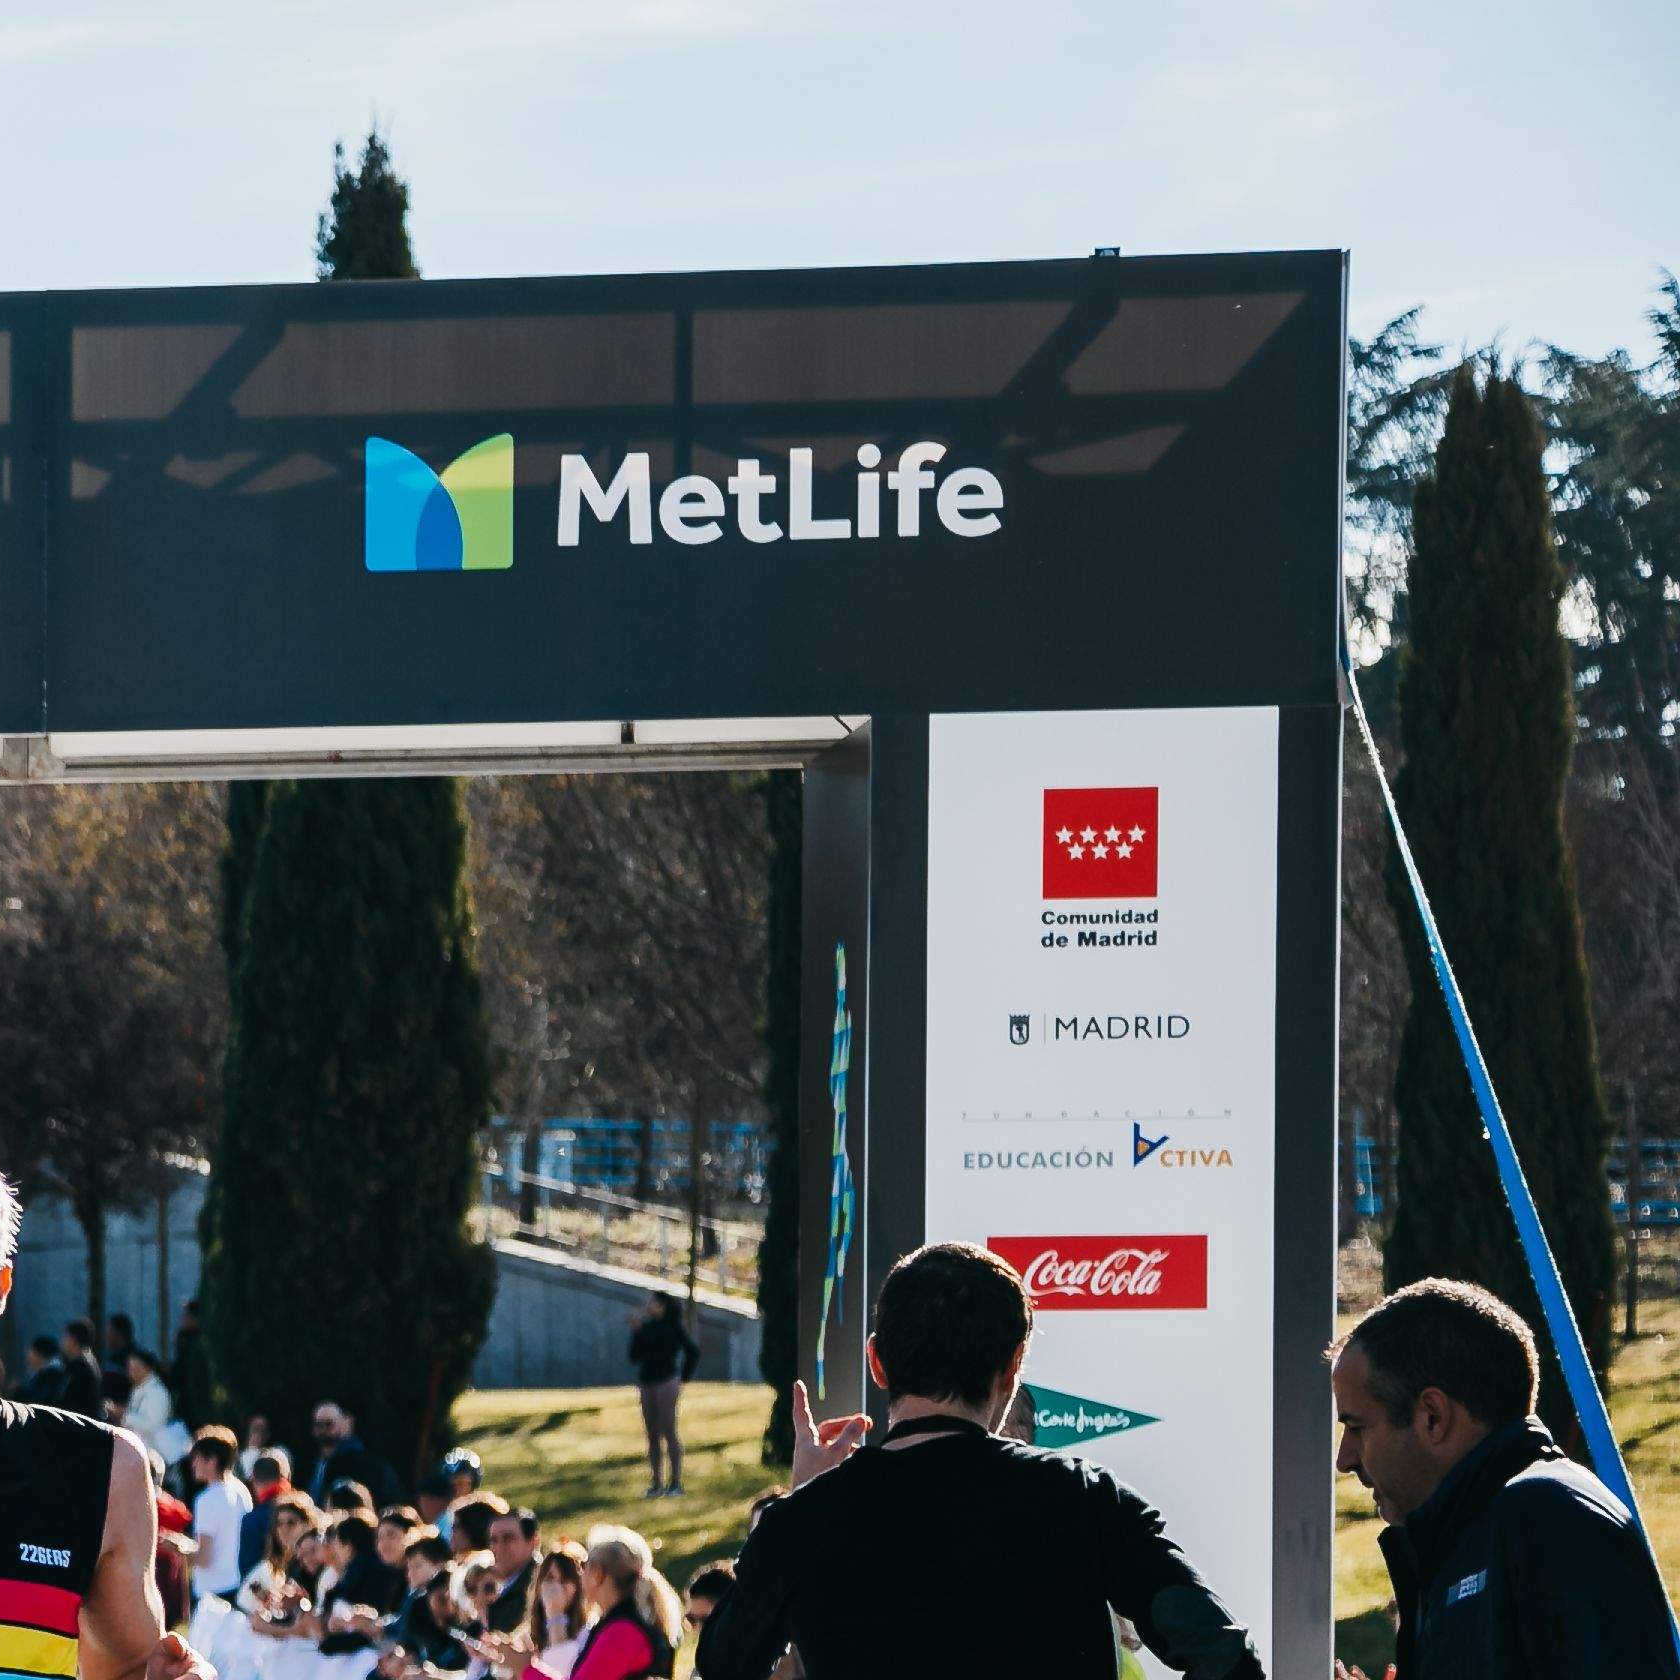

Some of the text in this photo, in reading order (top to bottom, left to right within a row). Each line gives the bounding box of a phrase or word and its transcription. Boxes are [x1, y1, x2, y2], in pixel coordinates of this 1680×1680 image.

[556, 441, 1005, 548] MetLife
[1041, 909, 1159, 926] Comunidad
[1041, 930, 1159, 948] de Madrid
[1055, 1015, 1191, 1041] MADRID
[963, 1145, 1114, 1169] EDUCACIÓN
[1024, 1248, 1170, 1297] Coca-Cola
[19, 1543, 72, 1568] 226ERS
